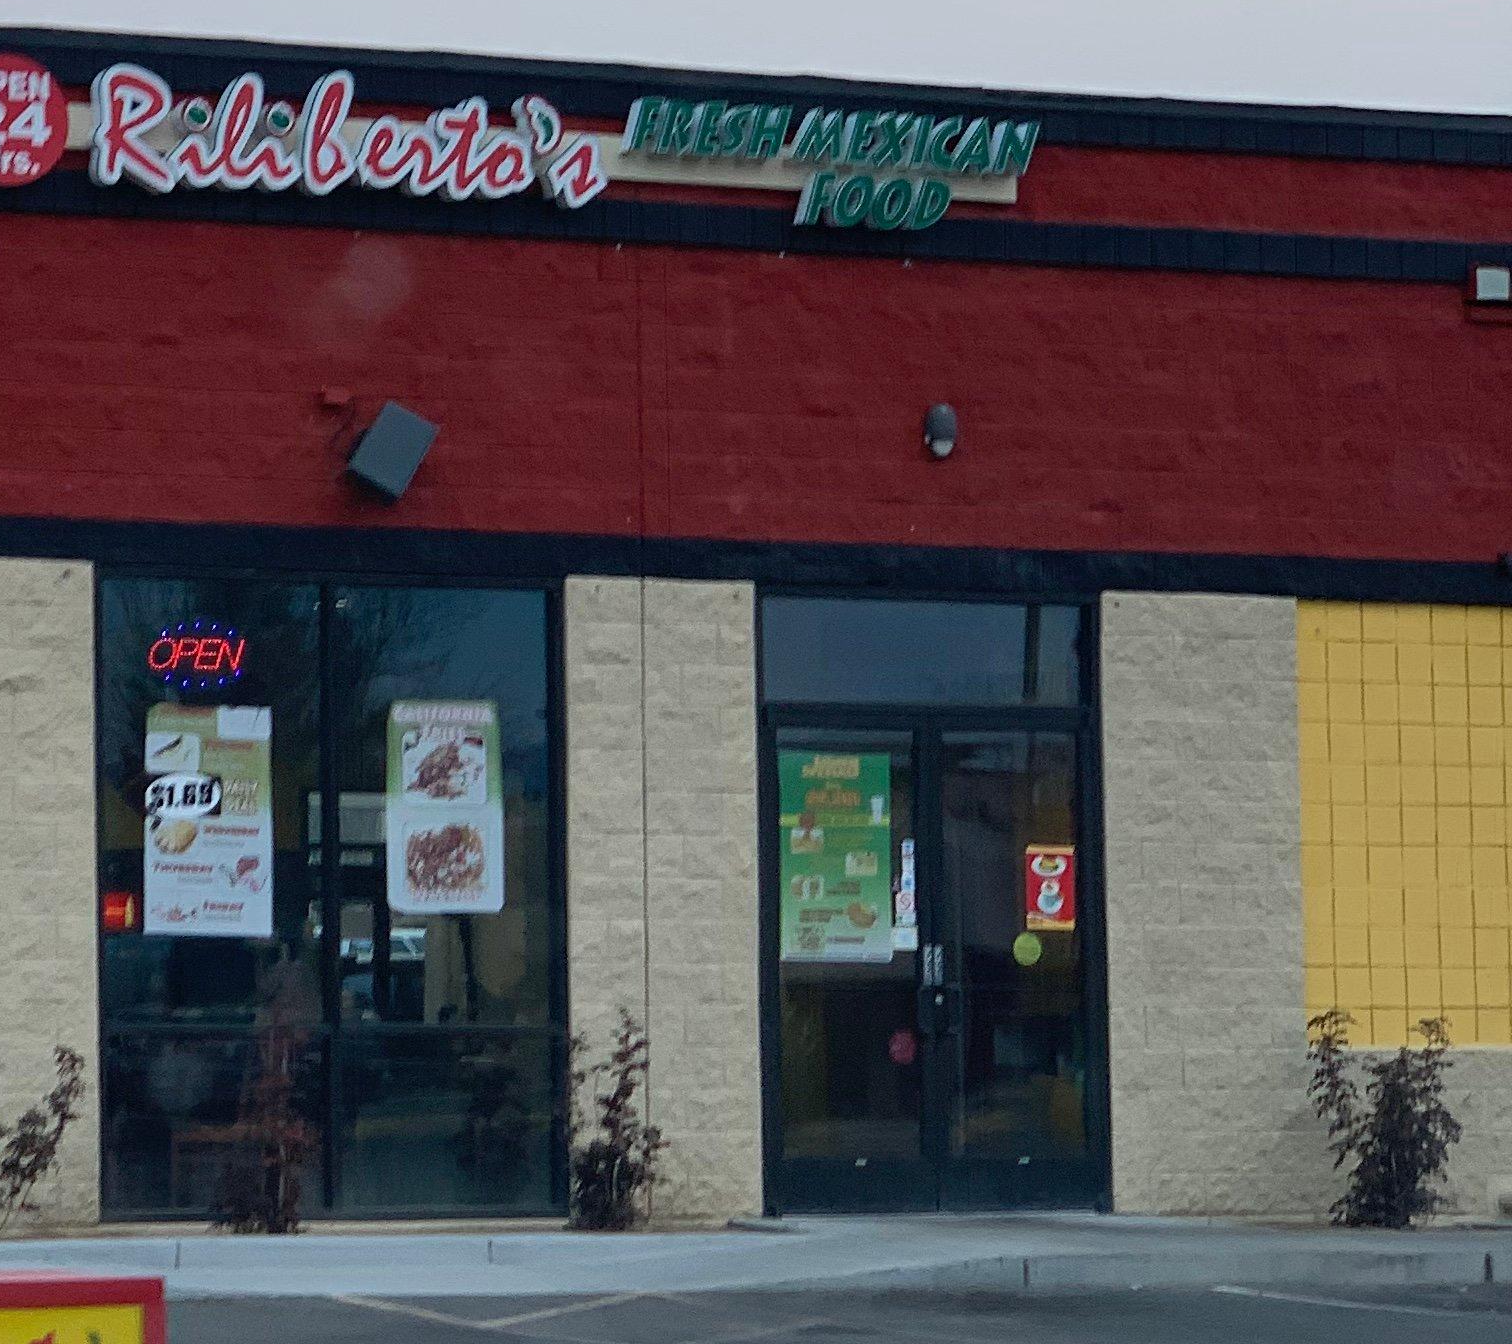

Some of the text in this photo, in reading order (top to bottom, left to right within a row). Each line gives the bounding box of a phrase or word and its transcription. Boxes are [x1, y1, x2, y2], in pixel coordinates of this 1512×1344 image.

[89, 62, 606, 208] Riliberto's
[621, 96, 1041, 175] FRESH MEXICAN
[793, 171, 954, 230] FOOD
[148, 636, 246, 672] OPEN
